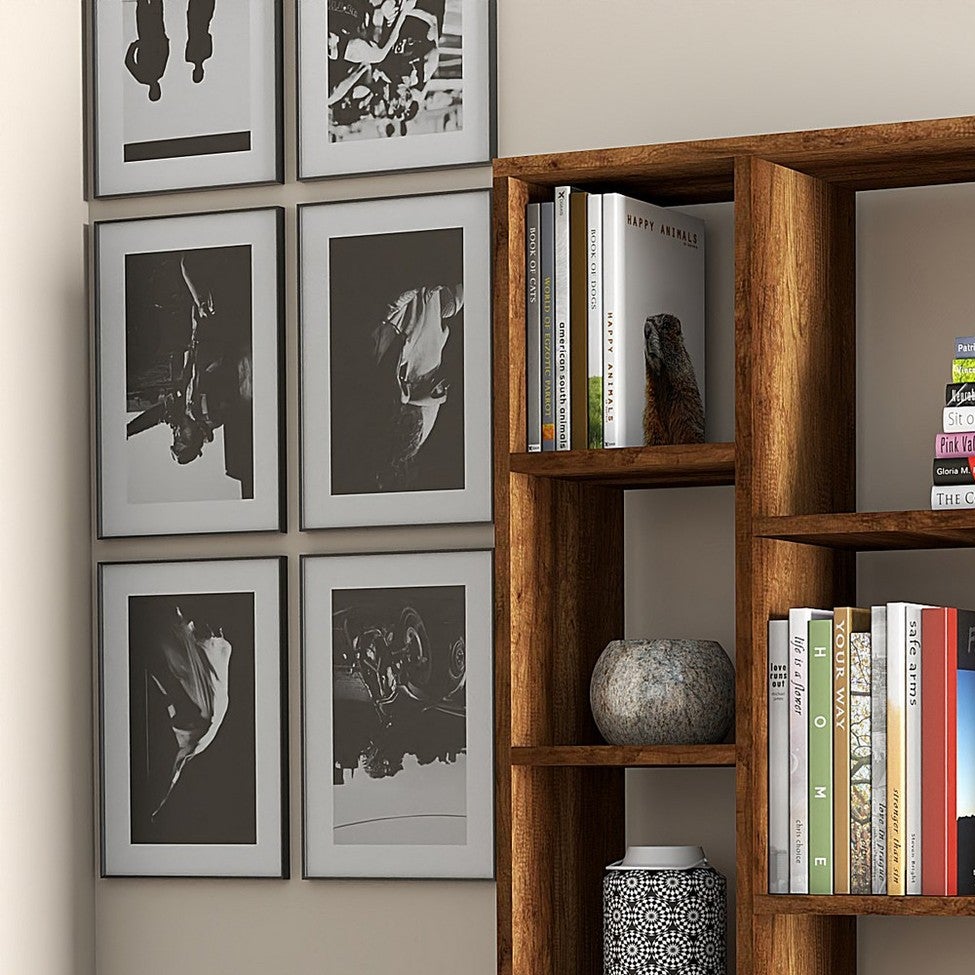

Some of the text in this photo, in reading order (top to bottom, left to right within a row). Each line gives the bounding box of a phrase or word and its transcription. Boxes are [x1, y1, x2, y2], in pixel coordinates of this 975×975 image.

[627, 214, 698, 244] HAPPY ANIMALS
[530, 260, 536, 273] OF
[590, 262, 596, 274] OF
[544, 316, 551, 328] OF
[948, 411, 963, 426] Sit
[560, 407, 568, 449] animals
[940, 436, 959, 453] Pink
[936, 467, 959, 476] Gloria
[960, 467, 971, 475] M.
[936, 492, 960, 506] THE
[770, 662, 787, 672] love
[909, 620, 921, 706] safe arms
[769, 672, 787, 680] runs
[790, 636, 805, 716] life is a flower
[835, 620, 845, 730] YOUR WAY
[771, 680, 785, 688] out
[795, 819, 804, 865] chris choice
[876, 802, 886, 882] love in prague
[891, 788, 902, 884] stranger than sin
